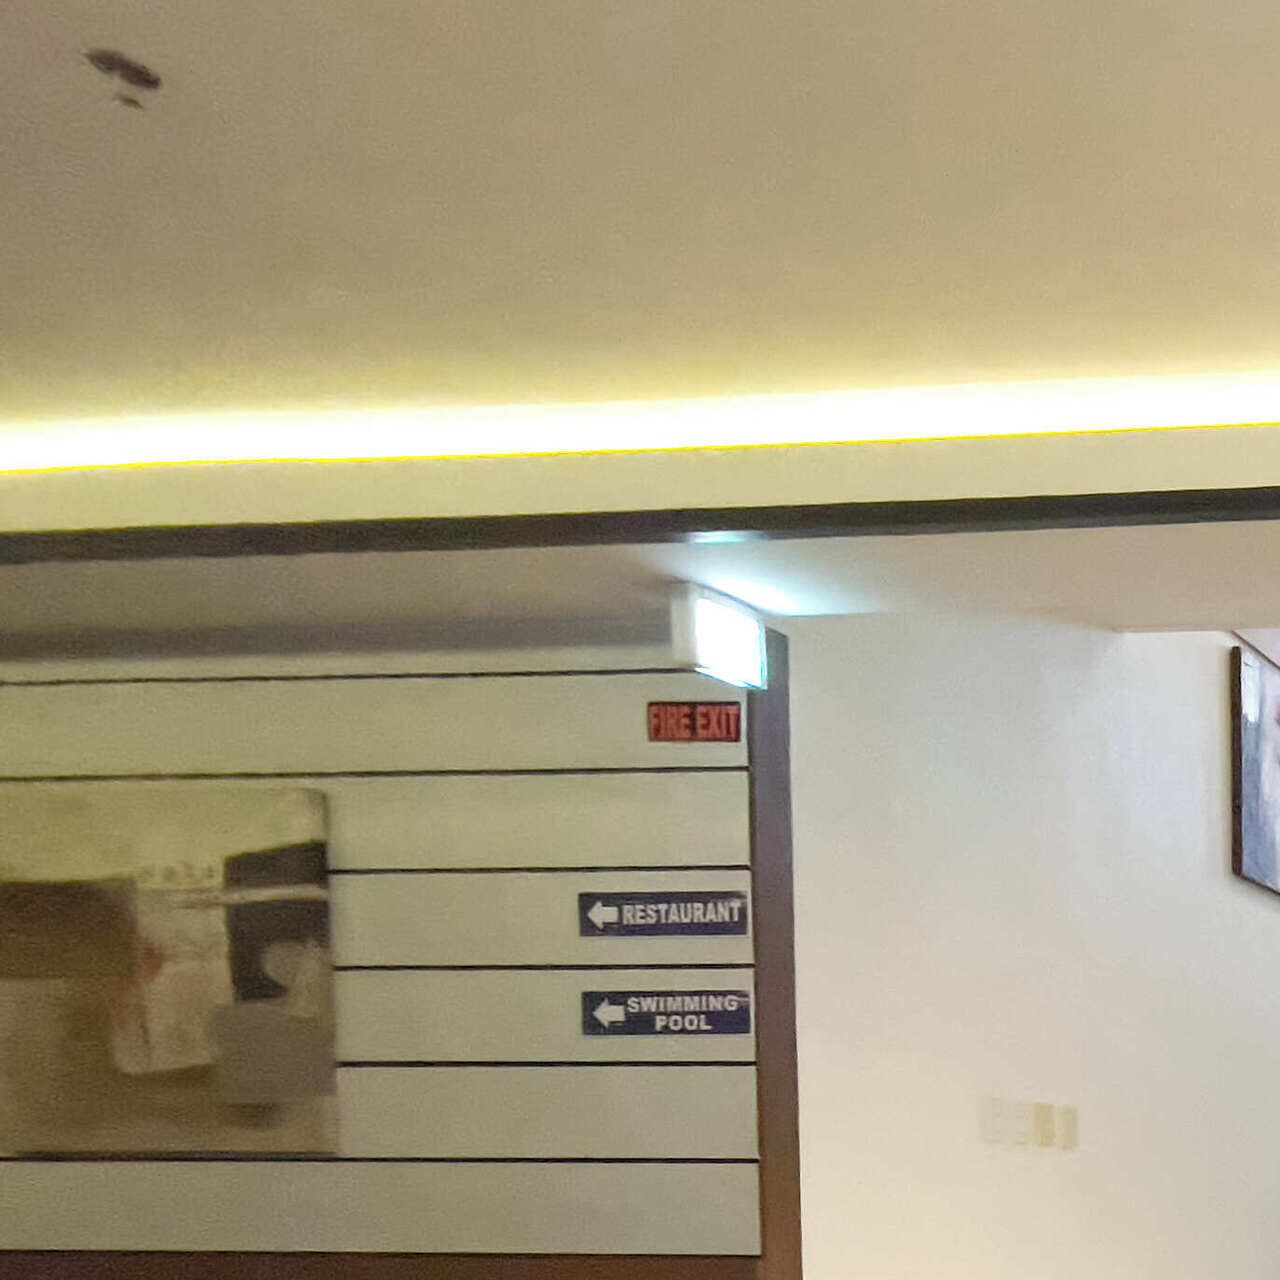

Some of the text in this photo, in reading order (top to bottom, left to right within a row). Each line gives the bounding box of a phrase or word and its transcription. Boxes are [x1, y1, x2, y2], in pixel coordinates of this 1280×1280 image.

[650, 703, 740, 739] FIRE EXIT
[622, 900, 743, 926] RESTAURANT
[627, 994, 739, 1014] SWIMMING
[654, 1014, 713, 1031] POOL
